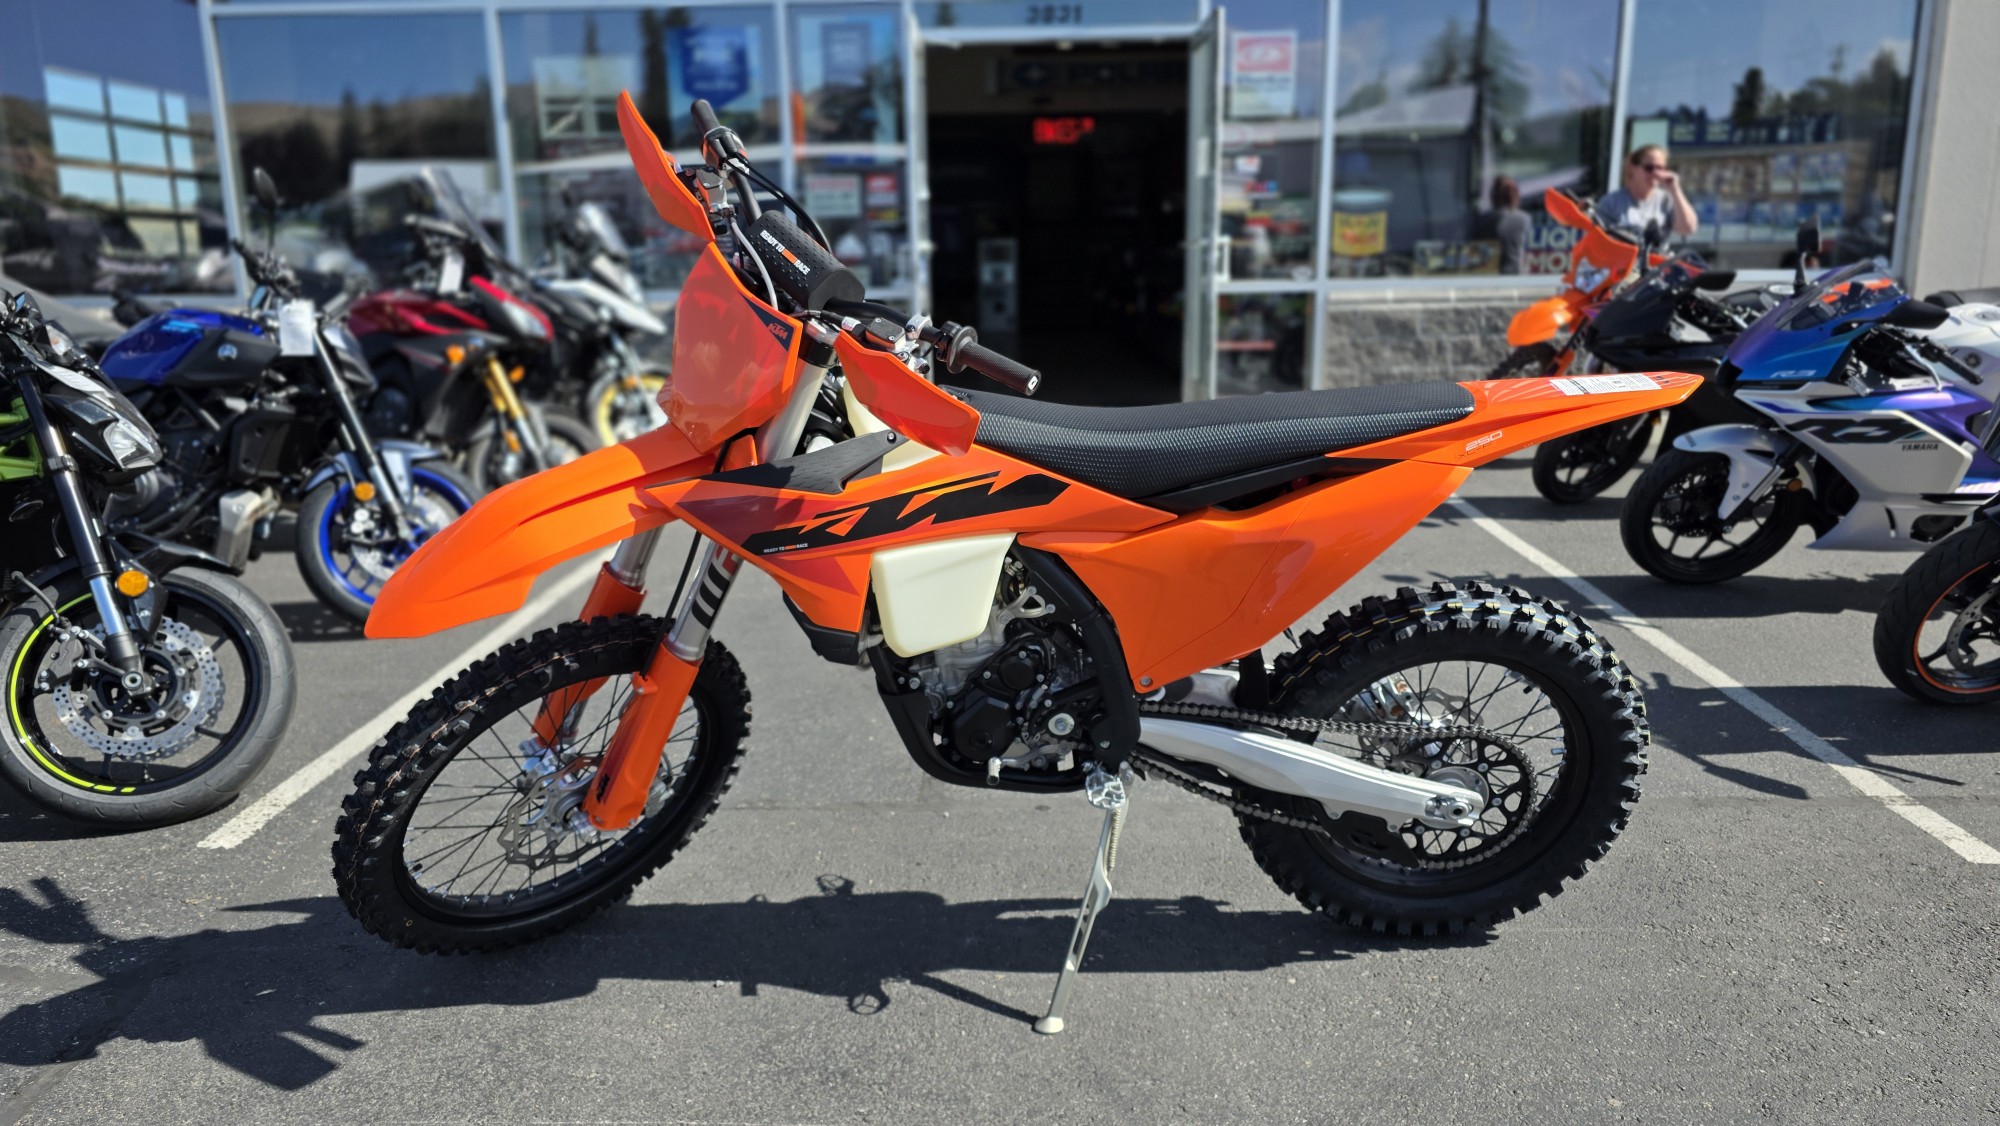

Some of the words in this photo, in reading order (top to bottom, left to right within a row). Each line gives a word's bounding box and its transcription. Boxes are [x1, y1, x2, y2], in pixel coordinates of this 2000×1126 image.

[760, 230, 777, 247] READY
[794, 259, 810, 275] RACE
[768, 322, 788, 340] KTM
[1465, 430, 1503, 451] 250
[1902, 443, 1939, 451] YAMAHA
[740, 470, 1072, 556] KTM
